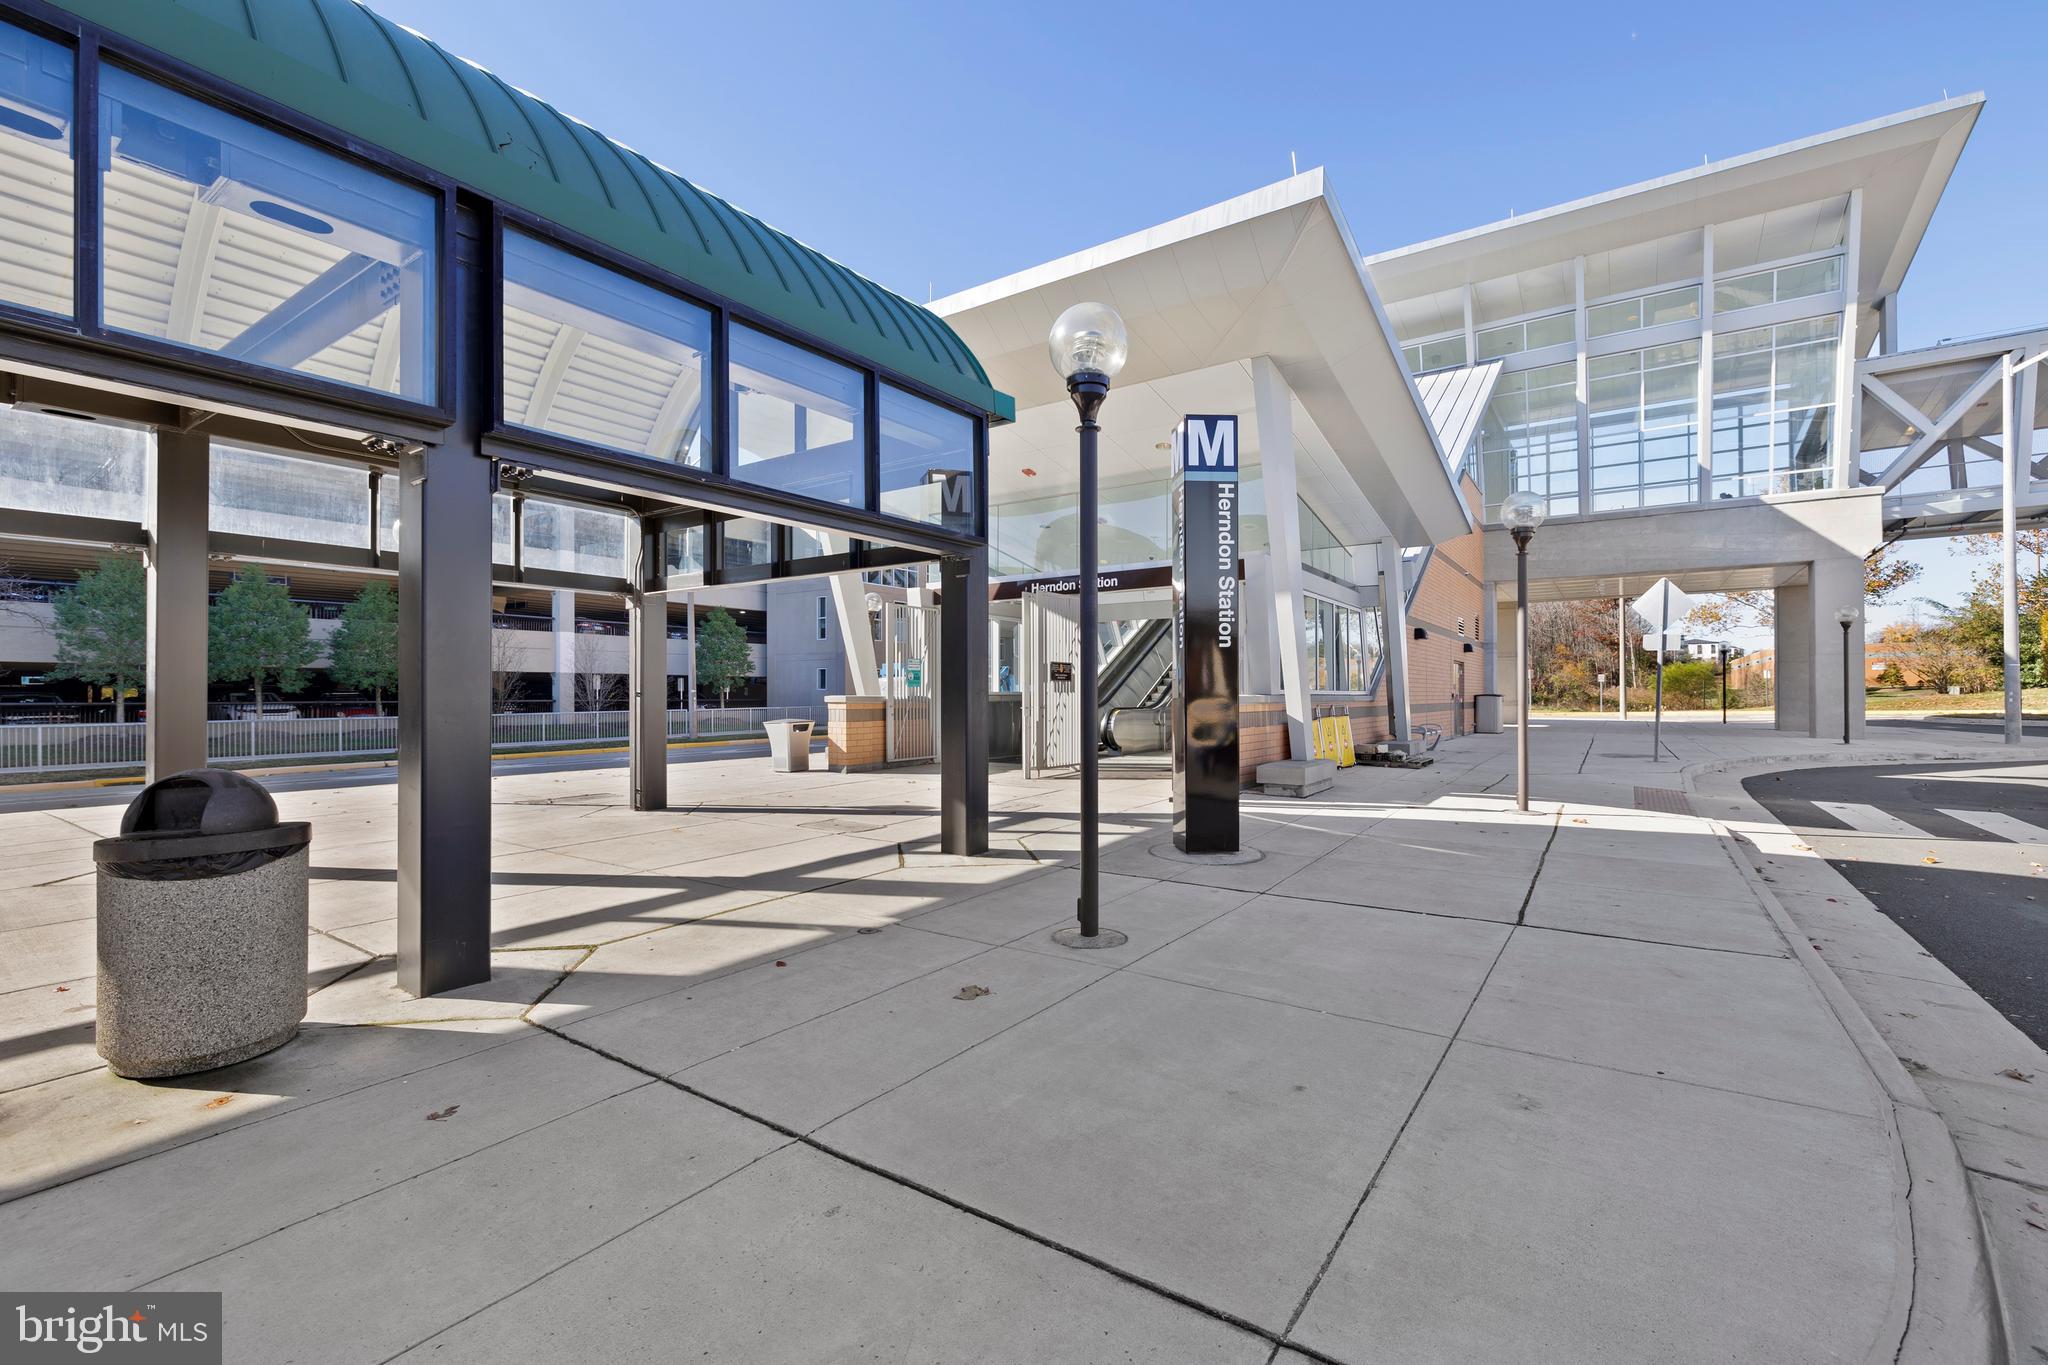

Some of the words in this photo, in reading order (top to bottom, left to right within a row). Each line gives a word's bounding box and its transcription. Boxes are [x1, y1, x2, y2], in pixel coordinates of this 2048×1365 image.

[1188, 420, 1234, 466] M
[1218, 483, 1235, 570] Herndon
[1031, 581, 1076, 594] Herndon
[1218, 575, 1235, 648] Station
